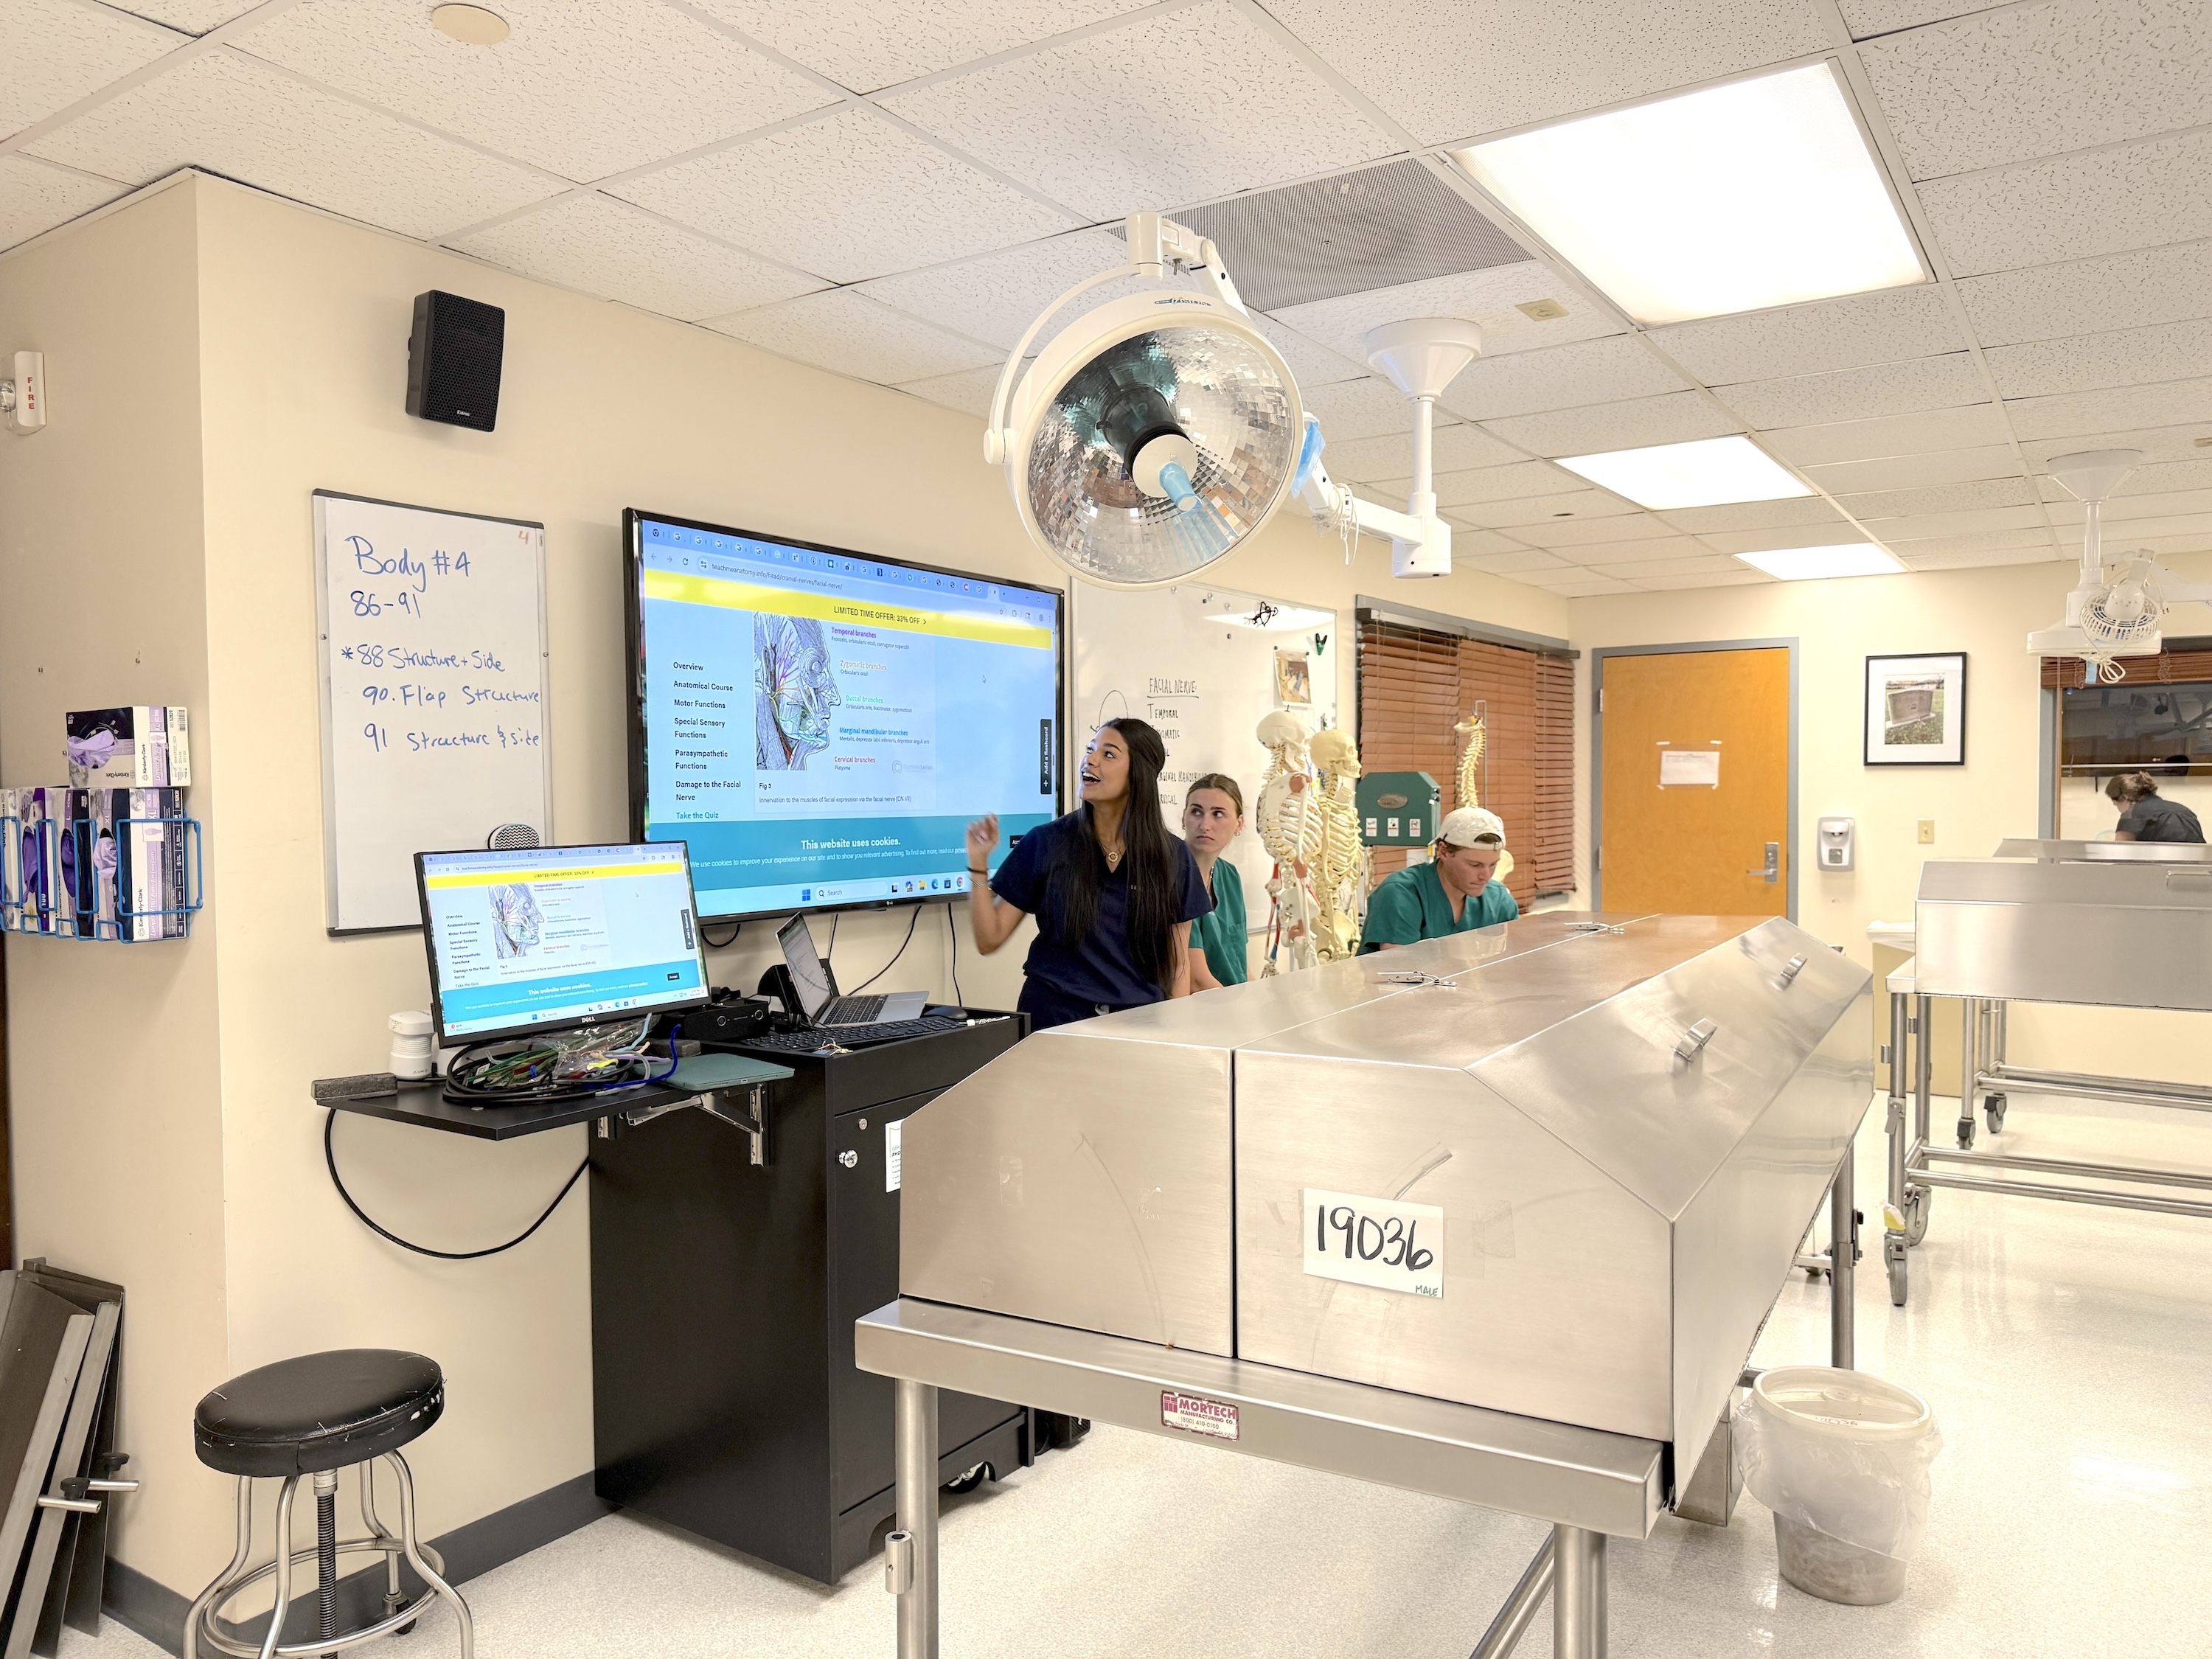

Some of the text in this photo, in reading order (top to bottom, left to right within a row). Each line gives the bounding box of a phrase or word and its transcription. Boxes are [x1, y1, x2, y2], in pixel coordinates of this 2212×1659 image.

[518, 530, 529, 545] 4
[344, 535, 471, 593] Body #4
[349, 590, 421, 619] 86-91
[833, 606, 858, 616] LIMITED
[860, 609, 874, 618] TIME
[875, 612, 895, 621] OFFER:
[897, 615, 908, 623] 33%
[832, 627, 876, 639] Temporal branches
[387, 647, 460, 669] Structure
[470, 650, 506, 672] Side
[673, 662, 703, 670] Overview
[841, 661, 886, 671] Zygomatic branches
[674, 681, 709, 689] Anatomical
[1150, 677, 1172, 694] FACIAL
[462, 685, 539, 705] Structure
[674, 699, 693, 707] Motor
[1147, 703, 1179, 720] TEMPORAL
[675, 717, 726, 728] Special Sensory
[364, 723, 388, 752] 91
[406, 731, 490, 751] Structure
[840, 727, 860, 735] Marginal
[675, 749, 728, 758] Parasympathetic
[675, 781, 703, 789] Damage
[801, 836, 900, 849] This website uses cookies.
[740, 858, 760, 866] improve
[1318, 1205, 1433, 1272] 19036
[1415, 1284, 1439, 1297] MALE
[1178, 1399, 1236, 1419] MORTECH
[1180, 1410, 1224, 1423] MANUFACTURING
[1181, 1416, 1194, 1425] (800)
[1196, 1420, 1220, 1429] 410-0100
